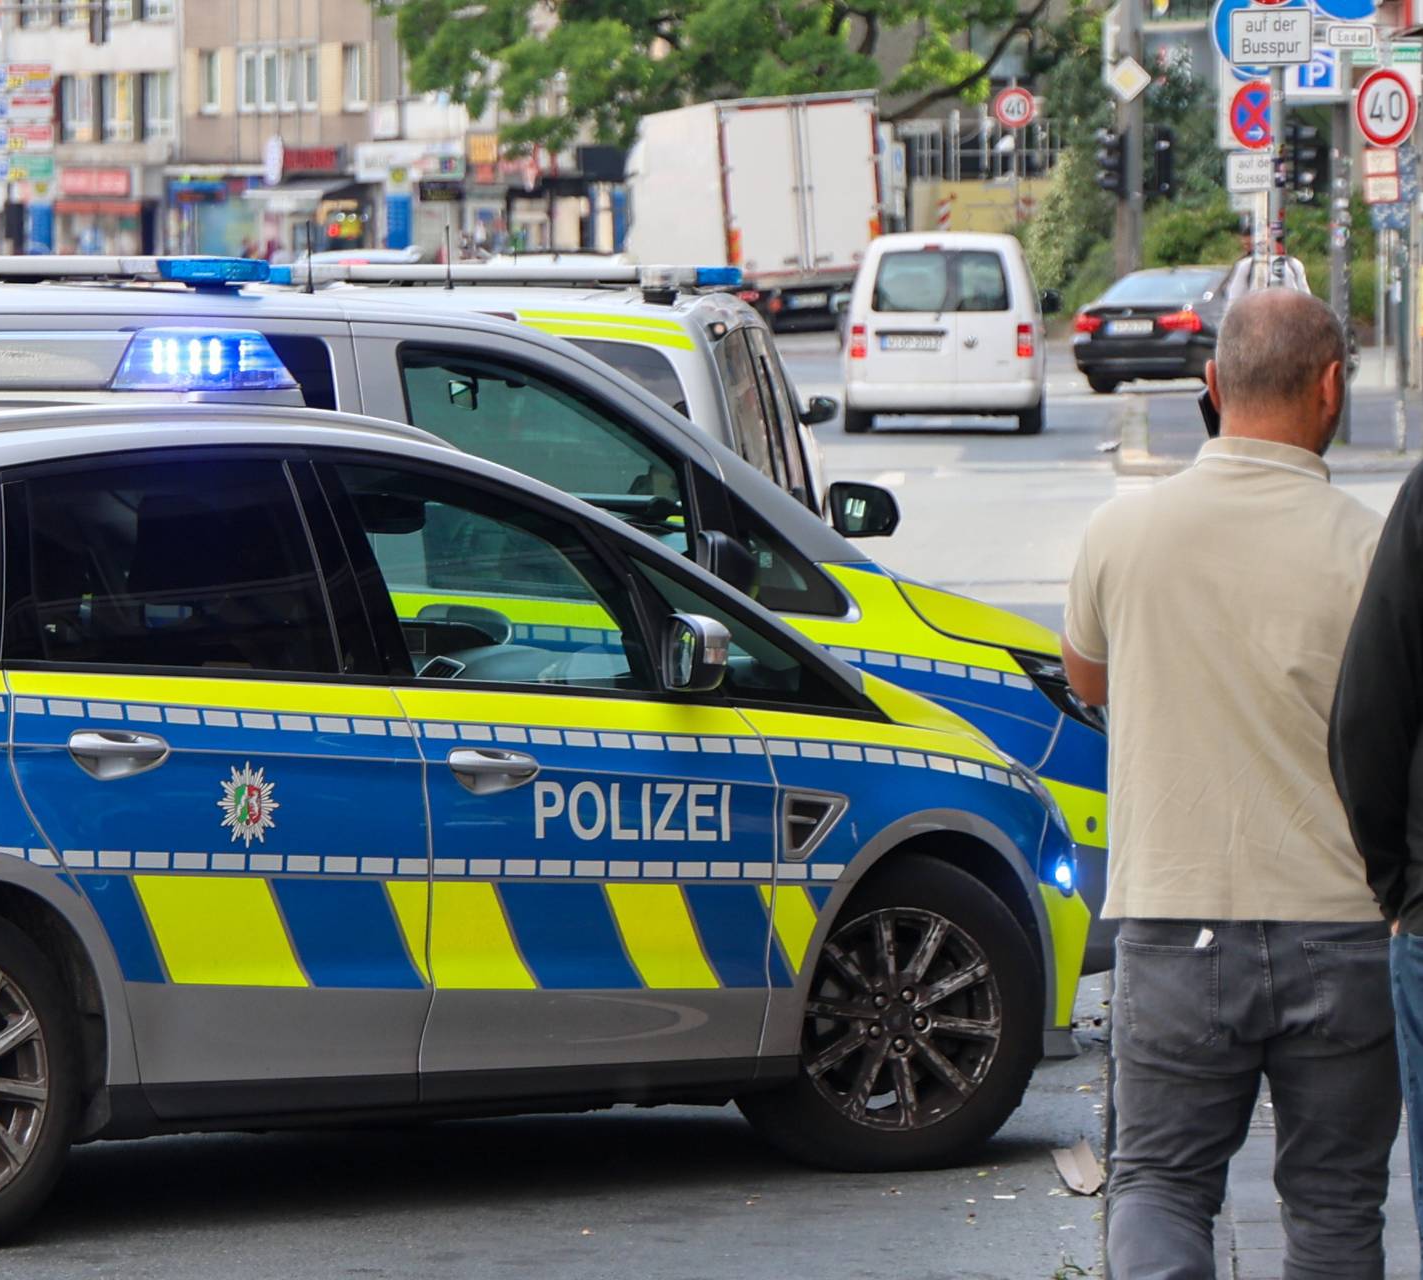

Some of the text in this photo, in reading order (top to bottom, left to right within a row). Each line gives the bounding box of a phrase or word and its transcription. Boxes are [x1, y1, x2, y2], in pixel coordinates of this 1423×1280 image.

[1245, 15, 1297, 32] auf der
[1241, 38, 1302, 57] Busspur
[1308, 61, 1326, 87] P
[1004, 100, 1028, 115] 40
[1370, 90, 1403, 122] 40
[1238, 158, 1270, 169] auf de
[1236, 172, 1270, 186] Bussp
[534, 780, 732, 842] POLIZEI
